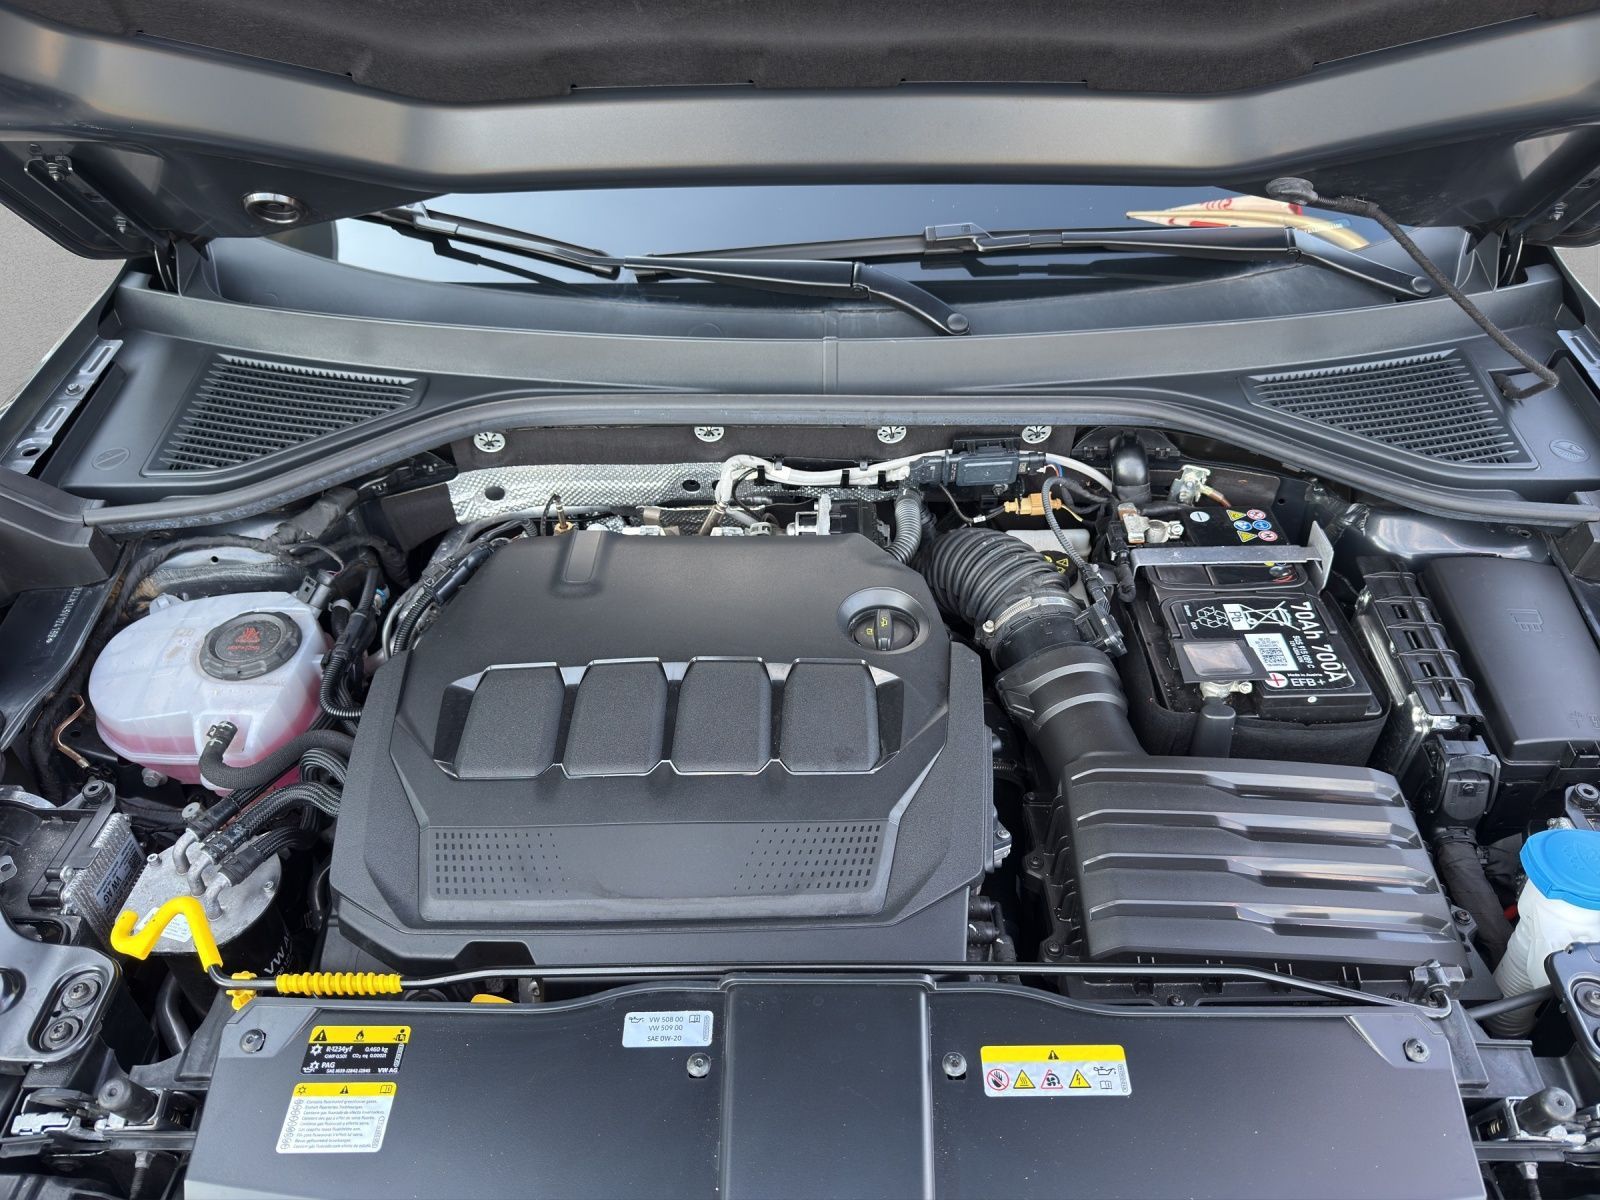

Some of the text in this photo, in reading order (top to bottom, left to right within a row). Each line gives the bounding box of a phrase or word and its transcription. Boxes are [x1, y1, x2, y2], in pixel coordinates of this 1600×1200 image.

[1228, 611, 1243, 622] Pb
[1290, 601, 1347, 682] 70Ah 700A
[112, 875, 122, 891] VW
[103, 887, 113, 904] AG
[263, 945, 285, 974] VW
[381, 1046, 389, 1054] kg
[321, 1061, 336, 1069] PAG
